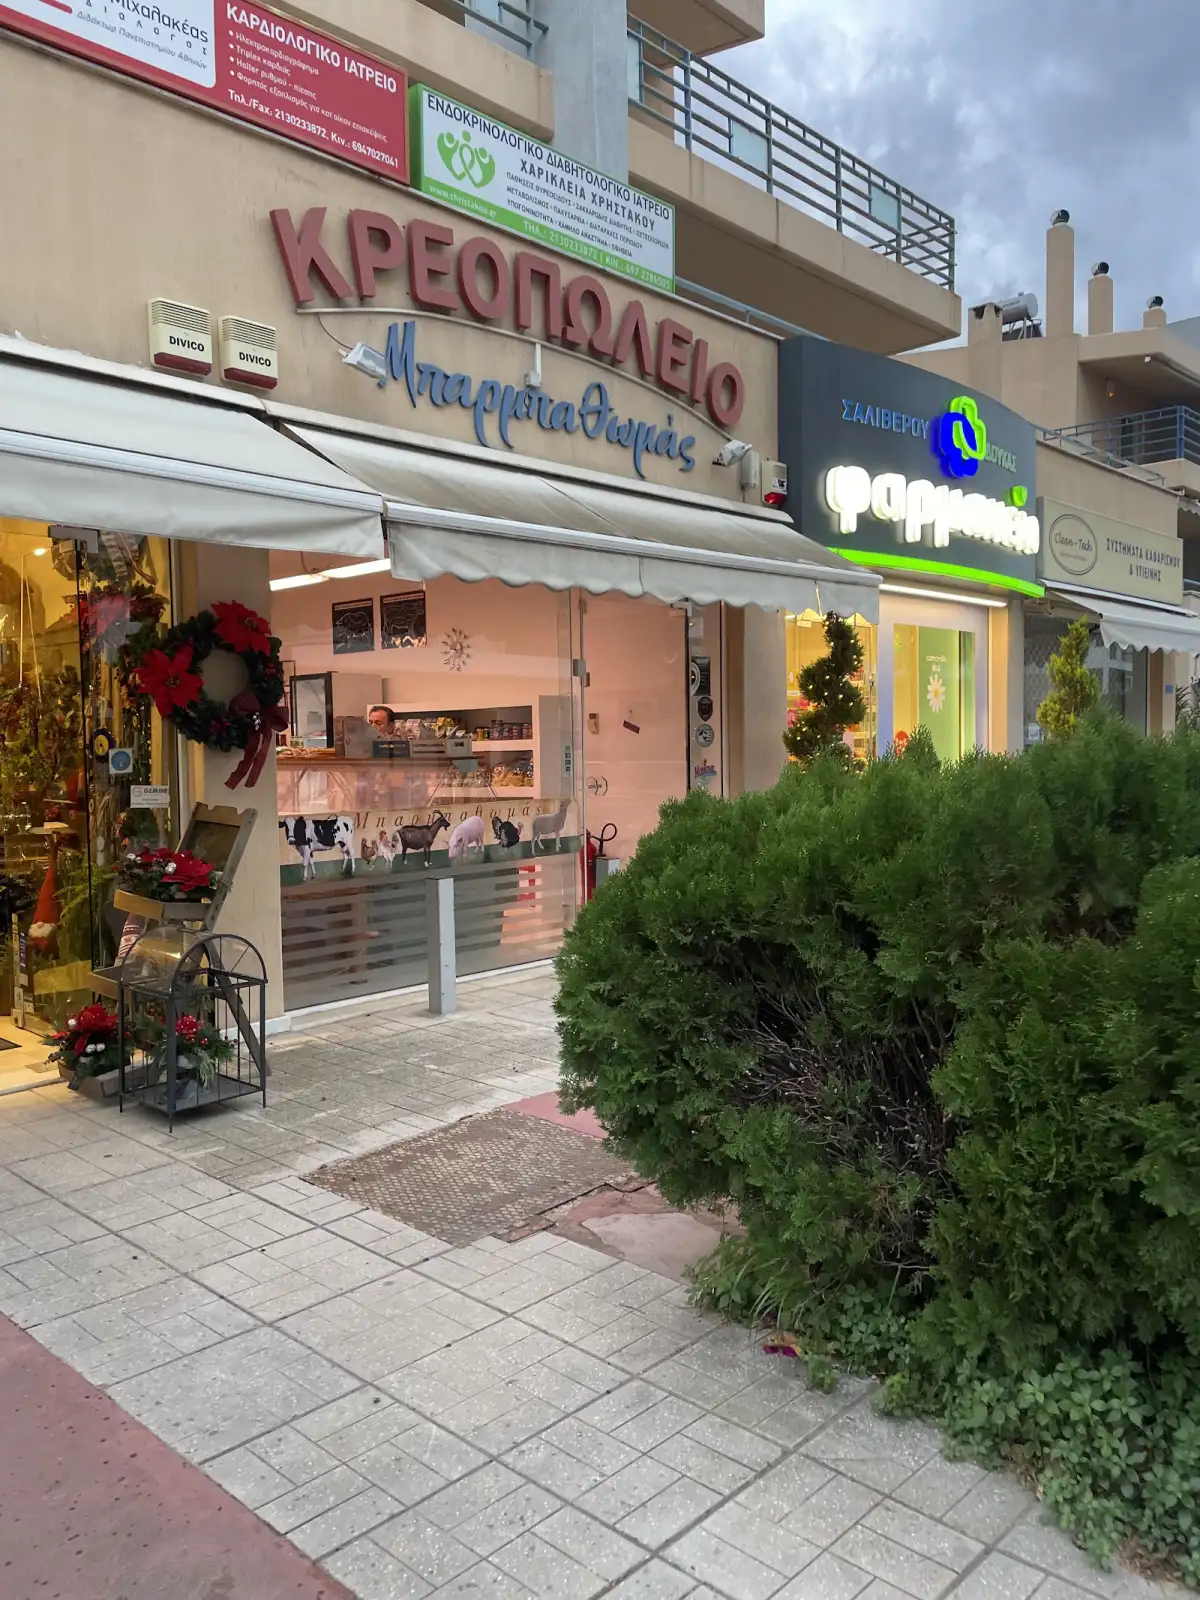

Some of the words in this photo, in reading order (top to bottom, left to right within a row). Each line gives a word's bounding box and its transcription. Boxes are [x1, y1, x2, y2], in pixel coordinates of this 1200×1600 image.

[77, 10, 116, 33] Διδάκτωρ
[119, 27, 176, 57] Πανεπιστημίου
[178, 51, 207, 70] Αθηνών
[111, 0, 209, 43] ιχαλακέας
[227, 3, 340, 67] ΚΑΡΔΙΟΛΟΓΙΚΟ
[344, 57, 397, 93] ΙΑΤΡΕΙΟ
[236, 32, 319, 75] Ηλεκτροκαρδιογράφημα
[236, 45, 261, 62] Triplex
[237, 73, 268, 92] Φορητός
[270, 85, 309, 109] εξοπλισμός
[309, 104, 320, 117] για
[261, 69, 287, 88] ρυθμού
[352, 140, 398, 168] 6947027041
[428, 93, 543, 160] ΕΝΔΟΚΡΙΝΟΛΟΓΙΚΟ
[546, 152, 631, 202] ΔΙΑΒΗΤΟΛΟΓΙΚΟ
[634, 193, 670, 220] ΙΑΤΡΕΙΟ
[507, 172, 534, 190] ΠΑΘΗΣΕΙΣ
[520, 158, 586, 200] ΧΑΡΙΚΛΕΙΑ
[591, 192, 655, 231] ΧΡΗΣΤΑΚΟΥ
[269, 206, 745, 428] ΚΡΕΟΠΩΛΕΙΟ
[169, 335, 205, 352] DIVICO
[239, 352, 271, 367] DIVICO
[842, 399, 929, 439] ΣΑΛΙΒΕΡΟΥ
[1107, 538, 1144, 560] ΣΥΣΤΗΜΑΤΑ
[1145, 549, 1180, 569] ΚΑΘΑΡΙΣΜΟΥ
[1136, 565, 1161, 582] ΥΓΙΕΙΝΗΣ
